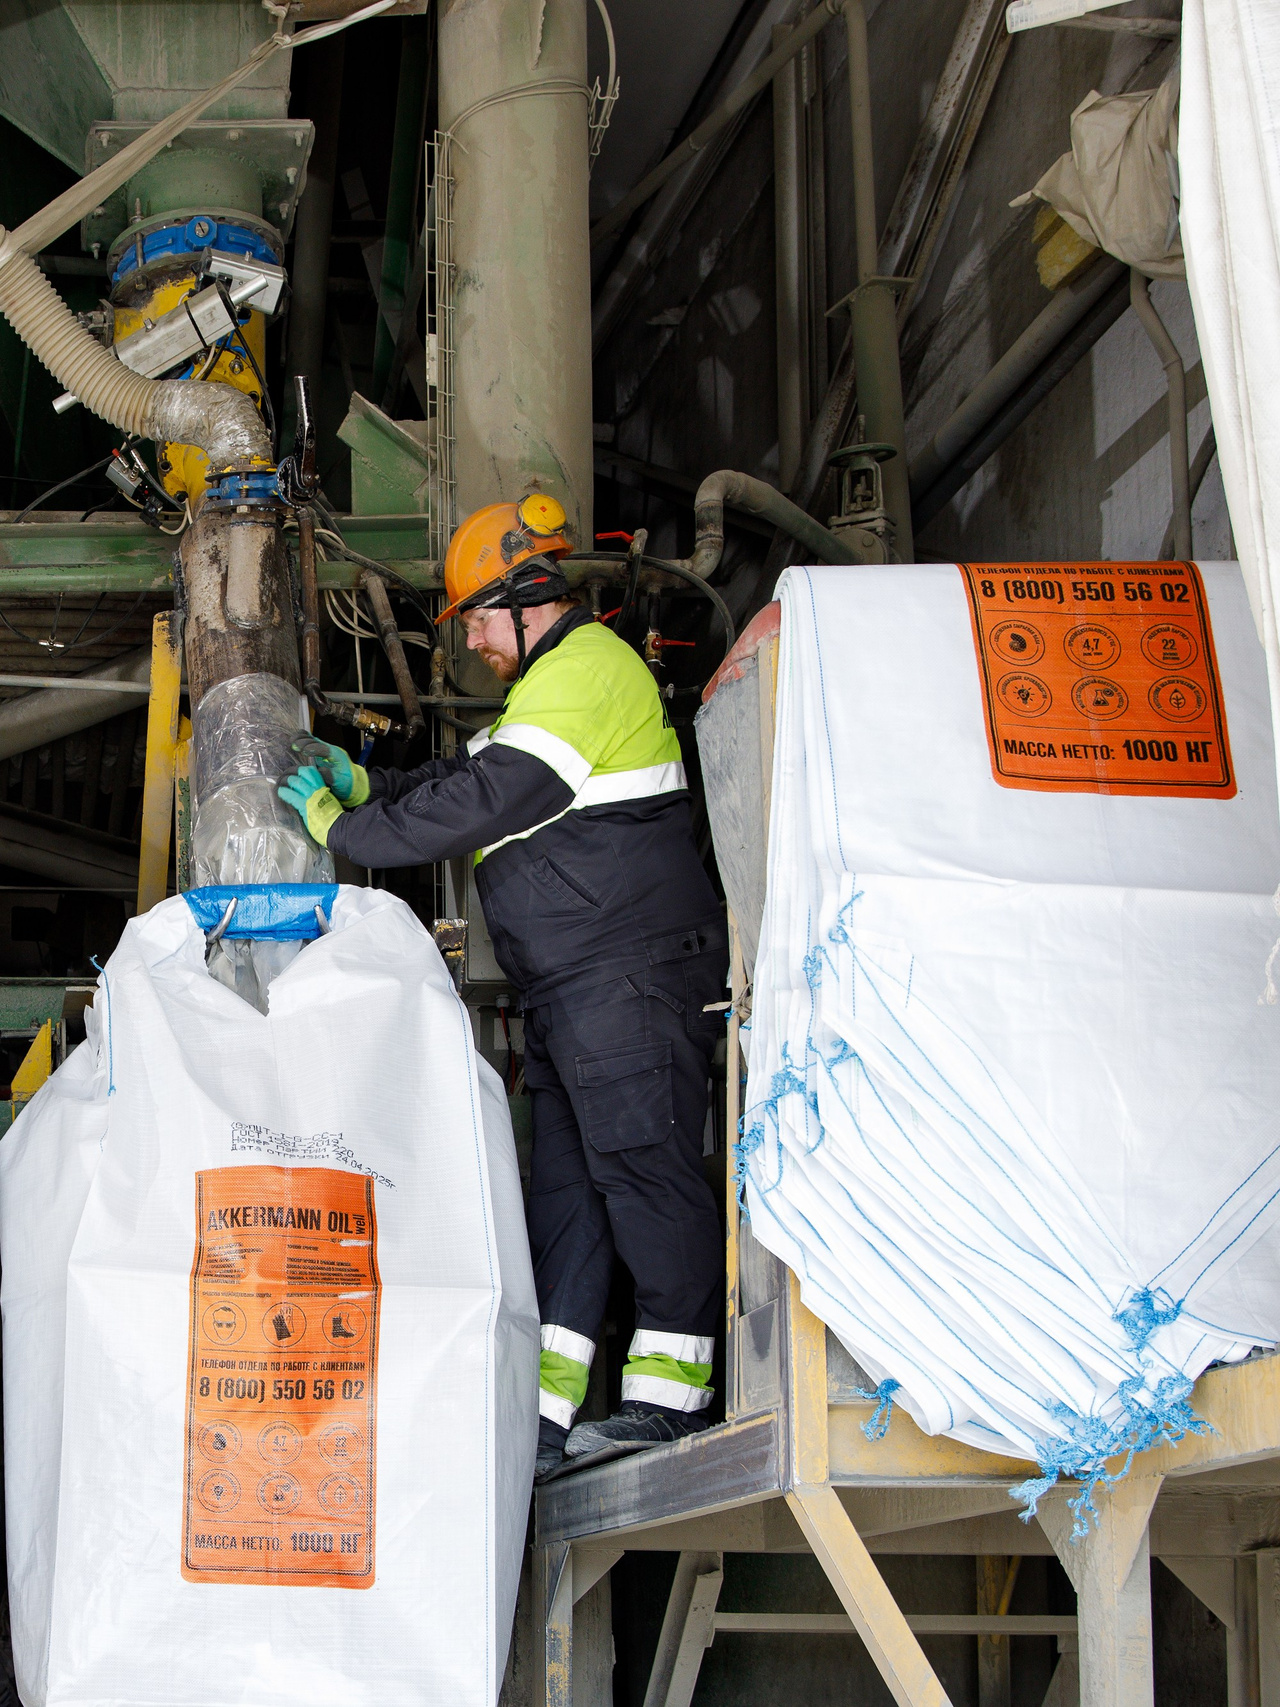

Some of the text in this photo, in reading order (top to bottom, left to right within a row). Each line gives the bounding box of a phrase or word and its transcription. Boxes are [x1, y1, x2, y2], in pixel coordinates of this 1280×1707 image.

[1024, 567, 1062, 575] ОТДЕЛА
[980, 579, 1190, 604] 8 (800) 550 56 02
[1083, 638, 1100, 651] 4,7
[1162, 638, 1177, 650] 22
[1003, 739, 1057, 758] МАССА
[1061, 744, 1116, 760] НЕТТО:
[1122, 739, 1178, 762] 1000
[332, 1144, 354, 1158] 220
[206, 1205, 366, 1235] AKKERMANN OIL well
[201, 1358, 236, 1370] ТЕЛЕФОН
[238, 1361, 268, 1372] ОТДЕЛА
[270, 1361, 281, 1371] ПО
[283, 1361, 310, 1371] РАБОТЕ
[313, 1362, 318, 1370] С
[199, 1376, 364, 1403] 8 (800) 550 56 02
[195, 1533, 237, 1550] МАССА
[242, 1535, 283, 1551] НЕТТО:
[290, 1531, 333, 1553] 1000
